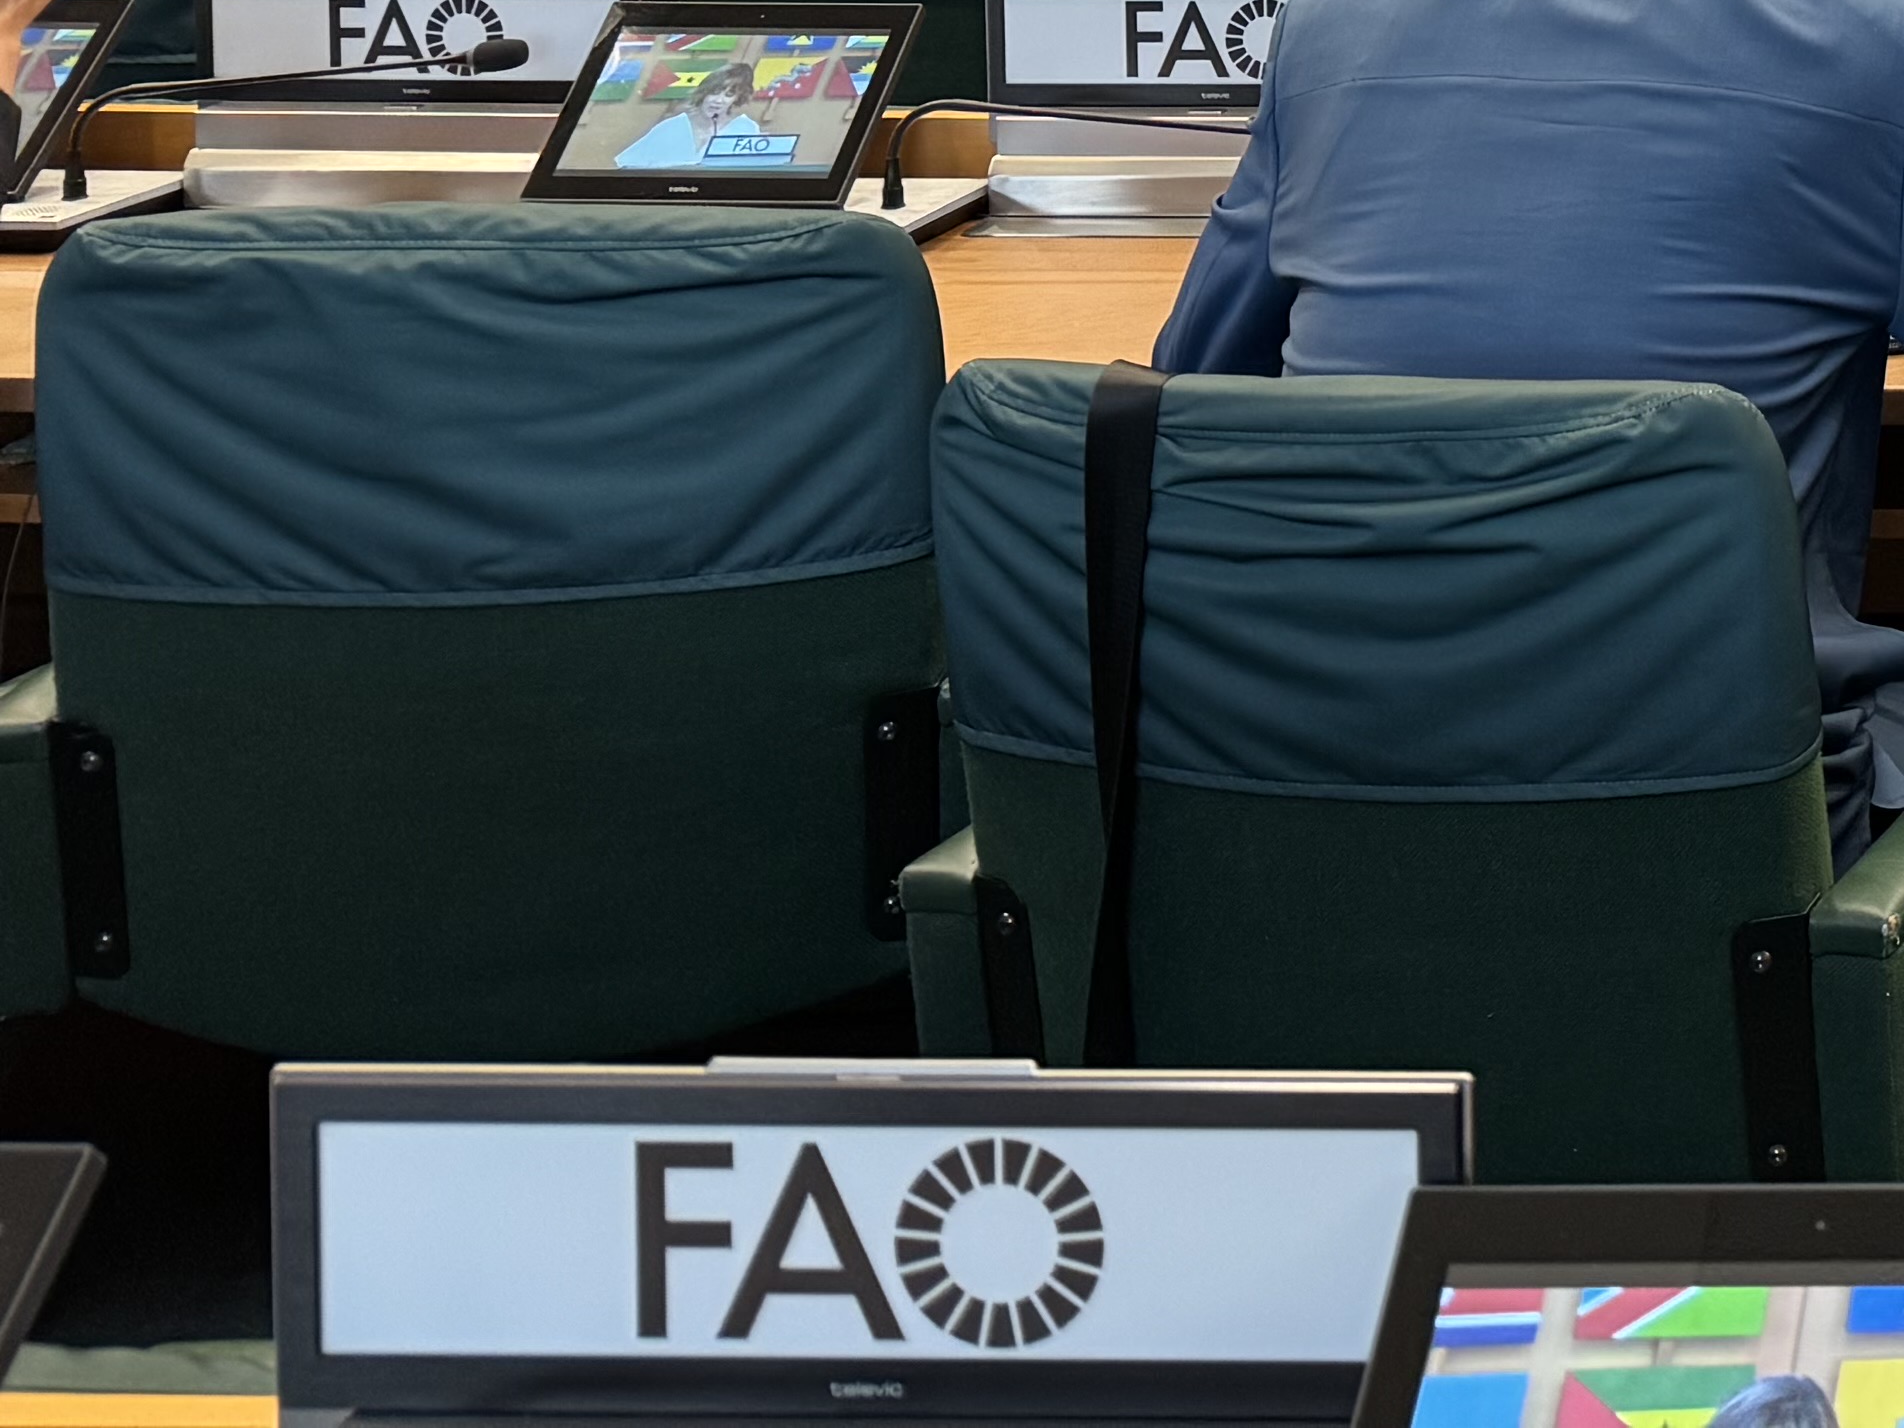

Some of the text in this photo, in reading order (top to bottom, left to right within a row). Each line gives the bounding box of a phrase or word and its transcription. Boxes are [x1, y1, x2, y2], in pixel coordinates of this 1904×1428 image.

[733, 137, 770, 153] FAO
[635, 1136, 1105, 1349] FAO
[829, 1381, 904, 1400] televic
